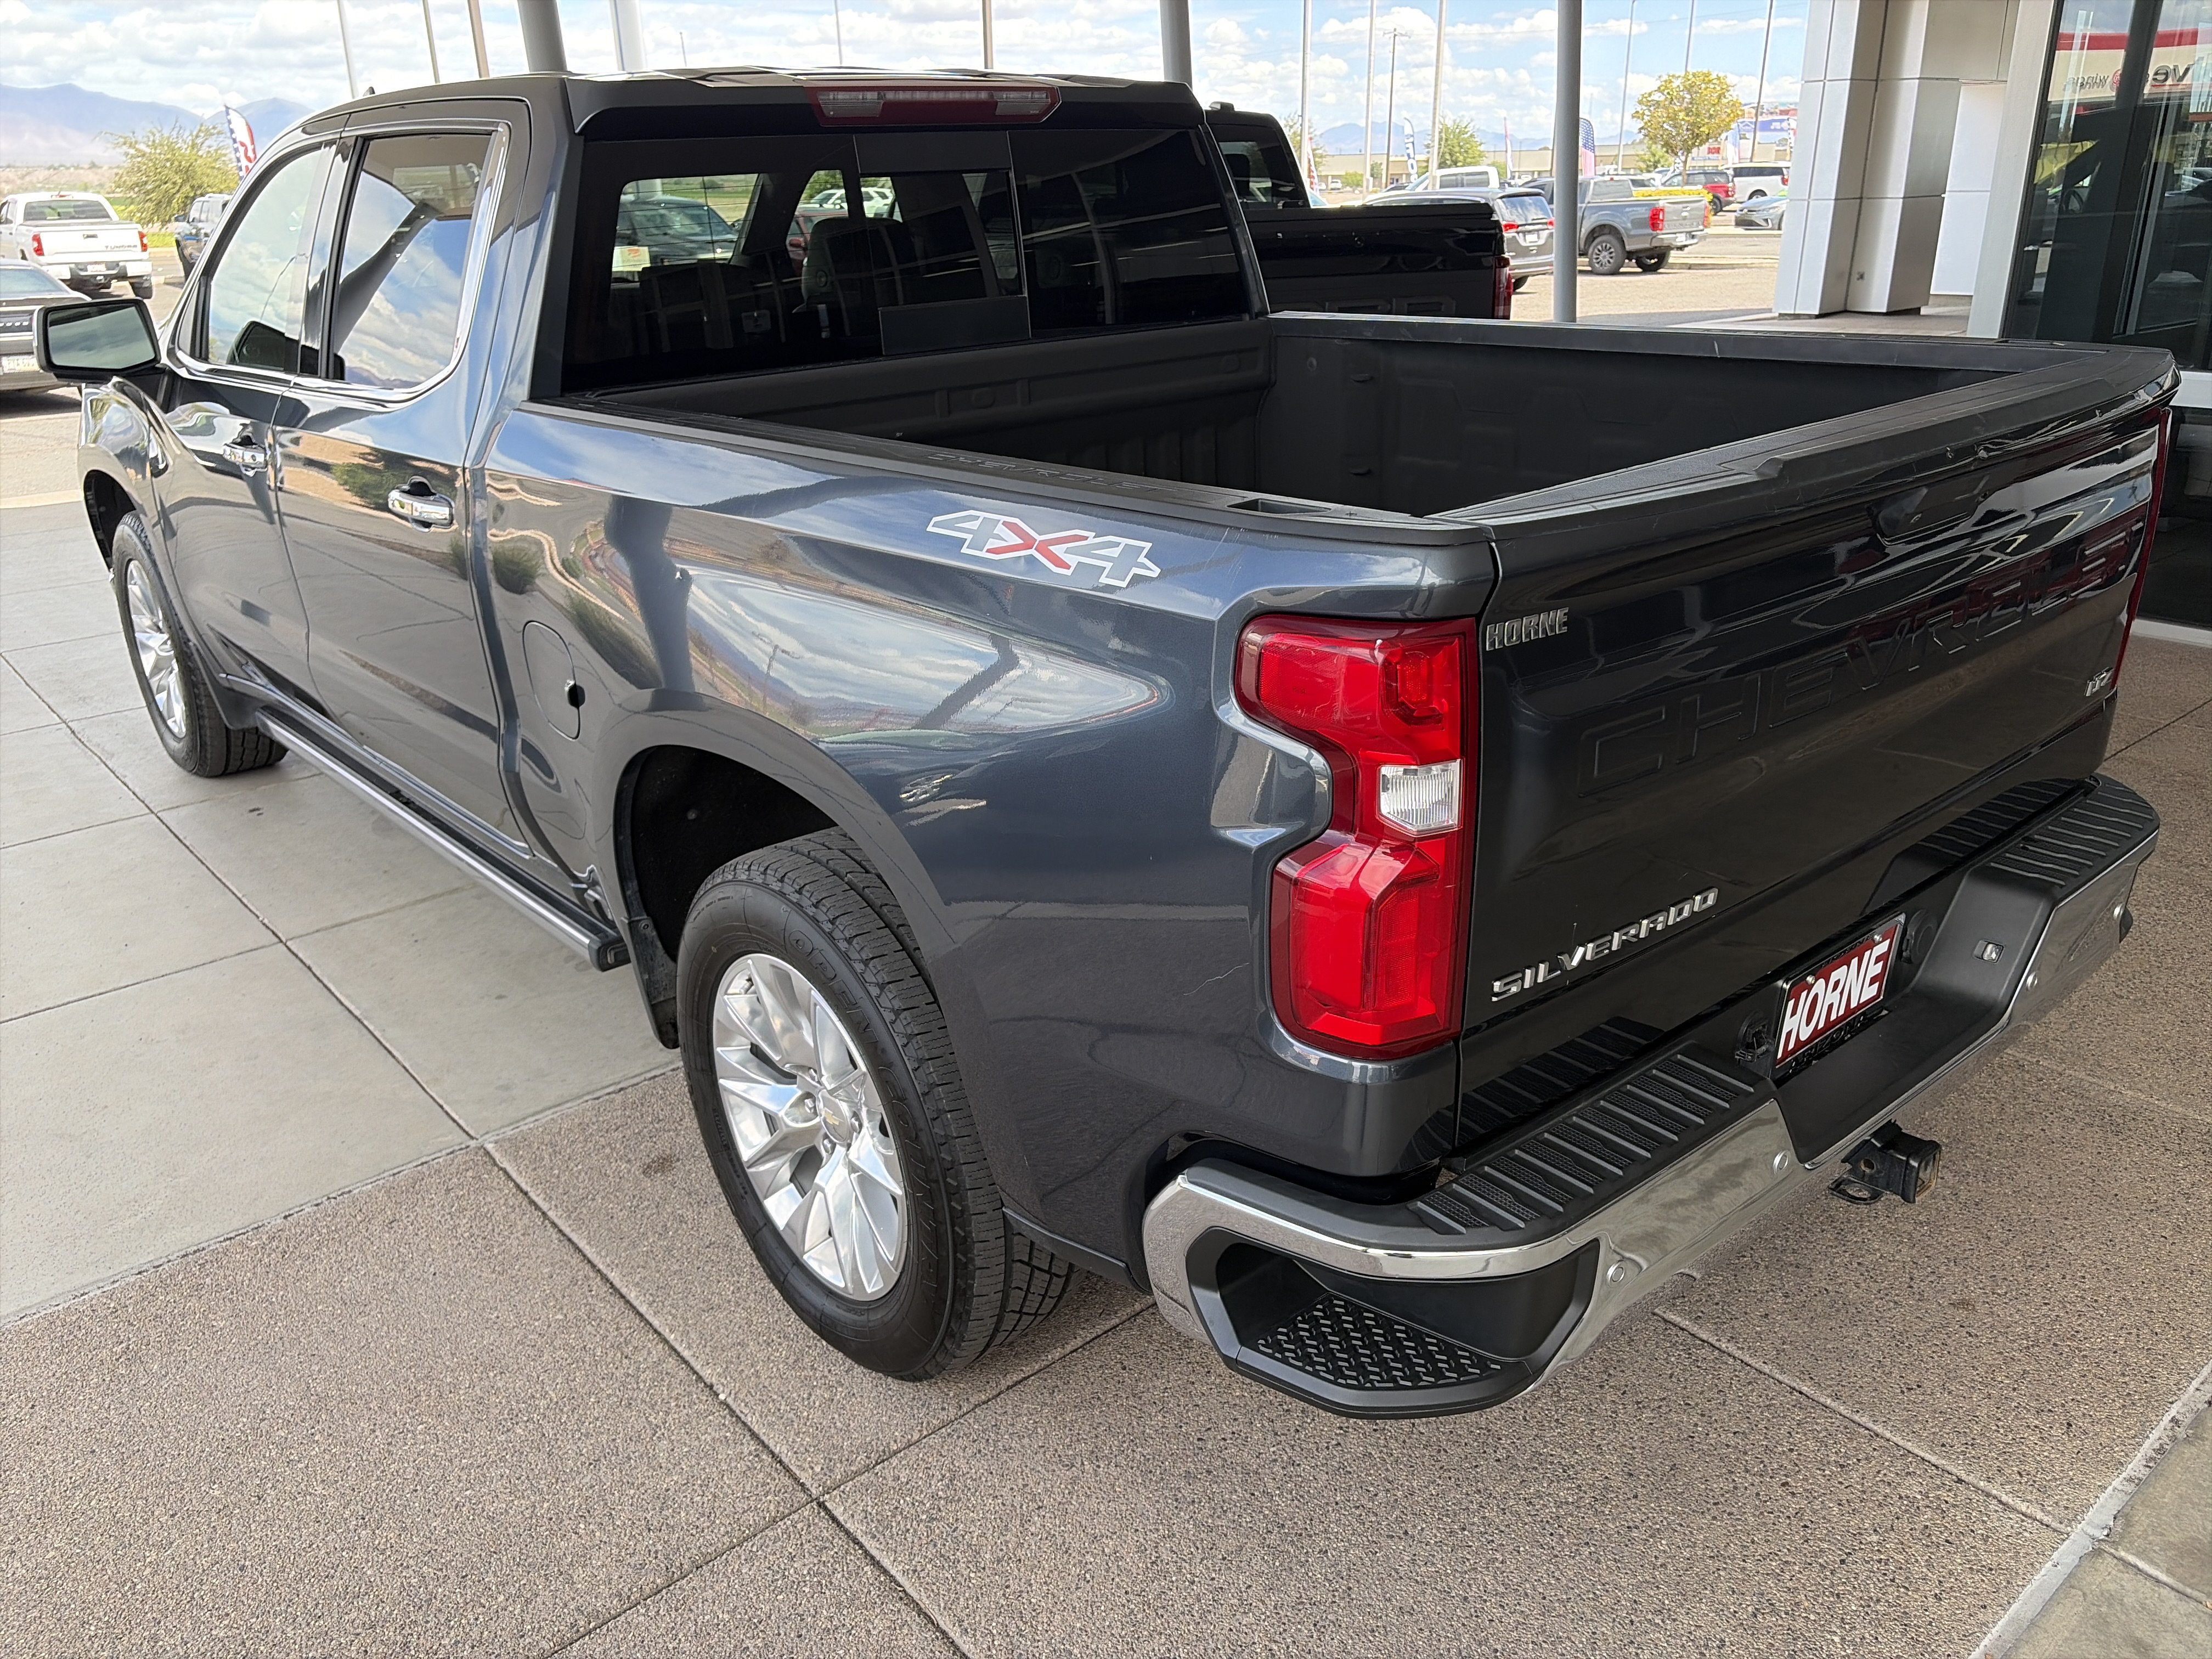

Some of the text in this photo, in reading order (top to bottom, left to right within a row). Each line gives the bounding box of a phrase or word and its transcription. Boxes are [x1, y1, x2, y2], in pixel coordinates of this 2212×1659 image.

[927, 453, 1178, 493] CHEVROLET
[1486, 607, 1569, 651] HORNE
[1577, 520, 2143, 797] CHEVROLET
[2084, 667, 2114, 696] LTZ
[1491, 886, 1718, 1002] SILVERADO
[1777, 938, 1891, 1059] HORNE
